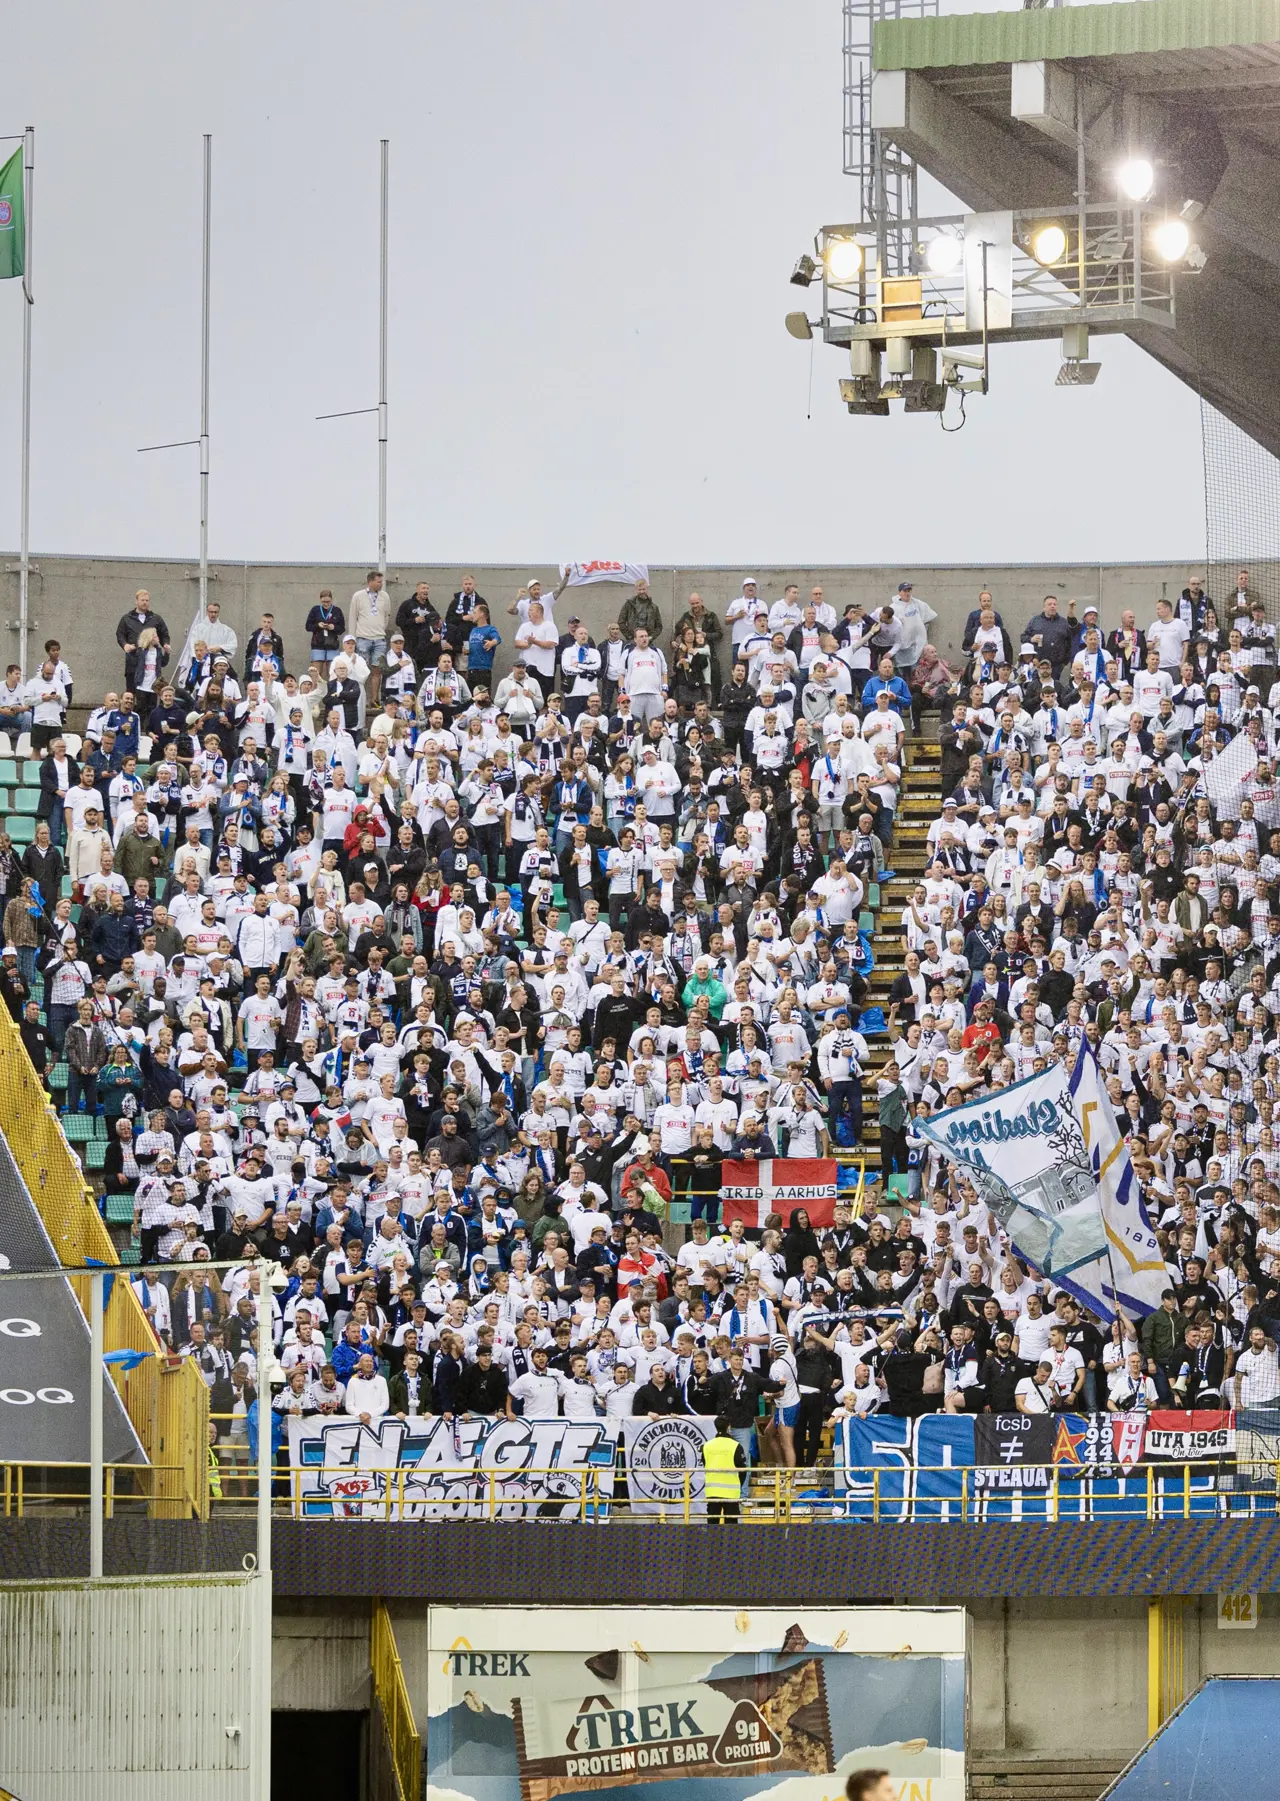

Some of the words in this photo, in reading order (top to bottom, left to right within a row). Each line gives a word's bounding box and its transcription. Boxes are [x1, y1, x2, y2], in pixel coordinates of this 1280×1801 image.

[1253, 791, 1274, 800] CERES
[775, 1185, 836, 1198] AARHUS
[994, 1414, 1032, 1431] fcsb
[1151, 1431, 1185, 1447] UTA
[1189, 1429, 1228, 1446] 1945
[322, 1423, 406, 1484] EN
[974, 1468, 1047, 1487] STEAUA
[649, 1481, 697, 1499] YOUTH
[1221, 1594, 1252, 1621] 412
[448, 1653, 531, 1677] TREK
[576, 1700, 704, 1750] TREK
[735, 1719, 760, 1741] 9g
[566, 1751, 636, 1777] PROTEIN
[637, 1747, 669, 1768] OAT
[673, 1742, 709, 1764] BAR
[725, 1740, 771, 1760] PROTEIN
